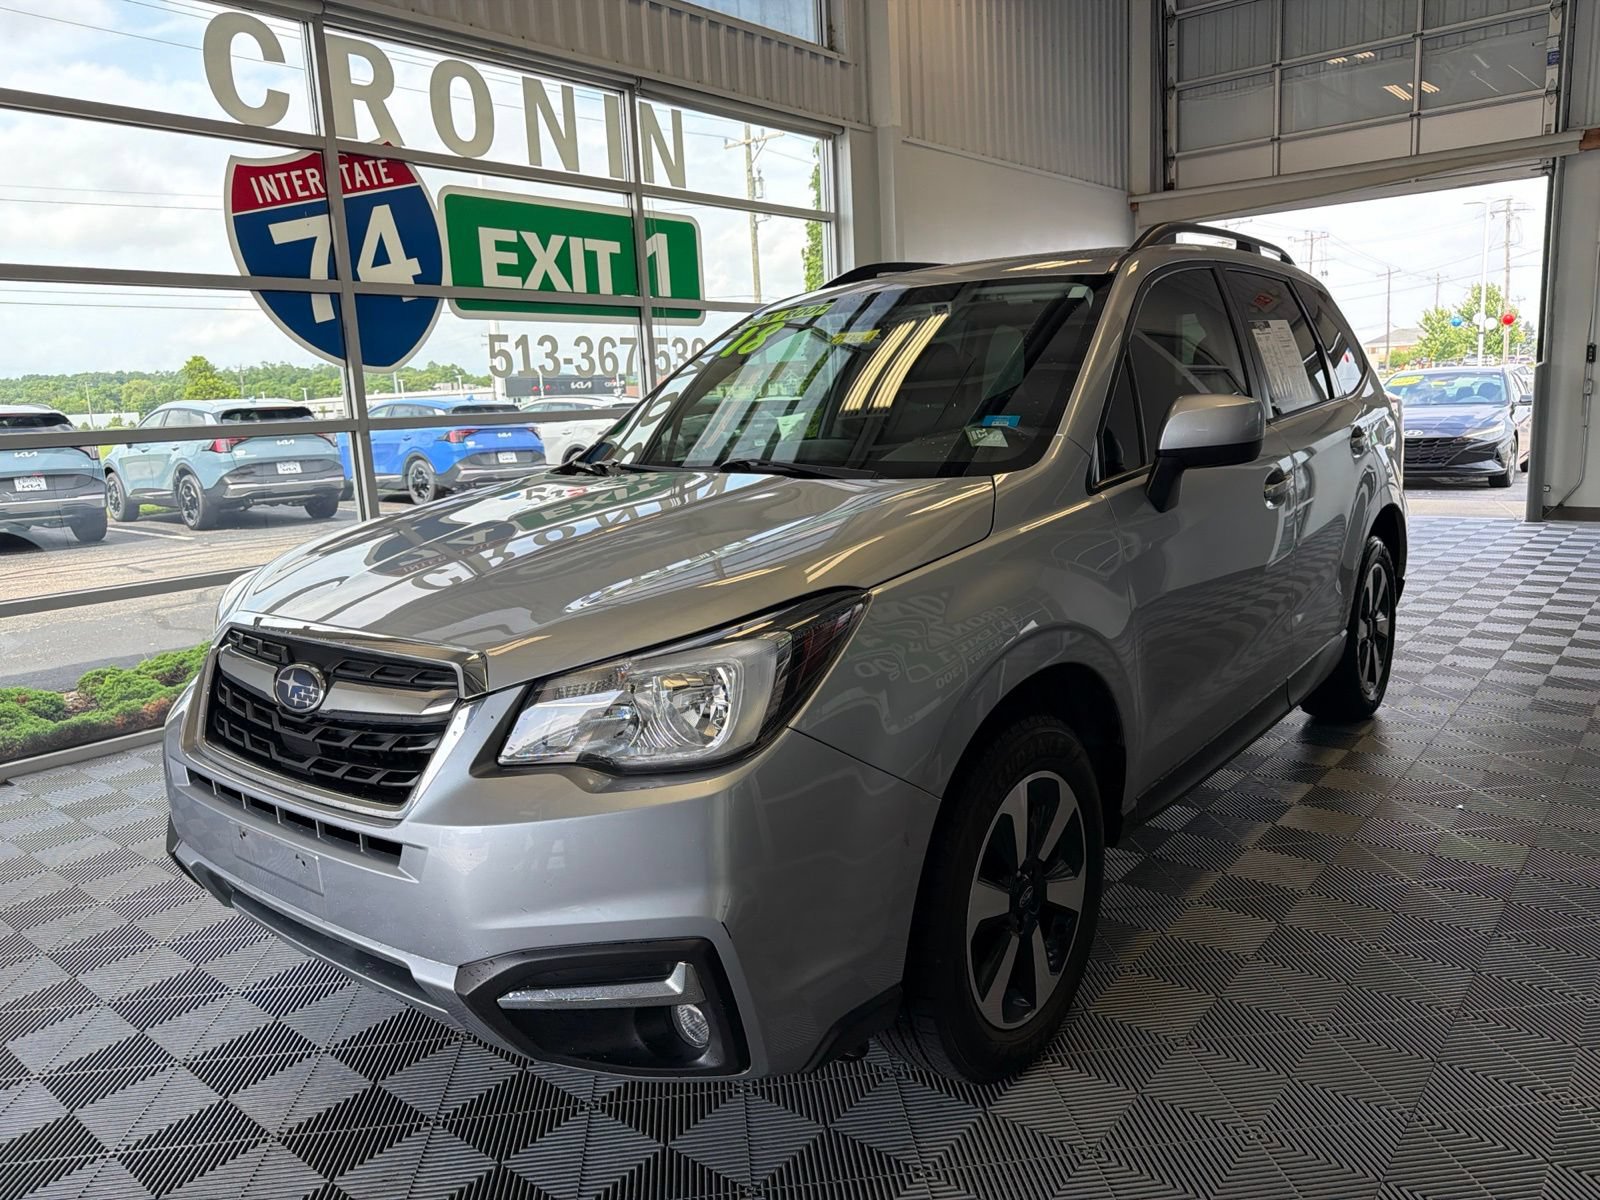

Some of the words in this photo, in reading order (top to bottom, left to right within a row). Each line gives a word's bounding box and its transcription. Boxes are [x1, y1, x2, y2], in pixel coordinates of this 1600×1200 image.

[203, 12, 686, 189] CRONIN
[251, 159, 394, 204] INTERTATE
[268, 204, 422, 323] 74
[478, 226, 621, 296] EXIT
[646, 233, 670, 298] 1
